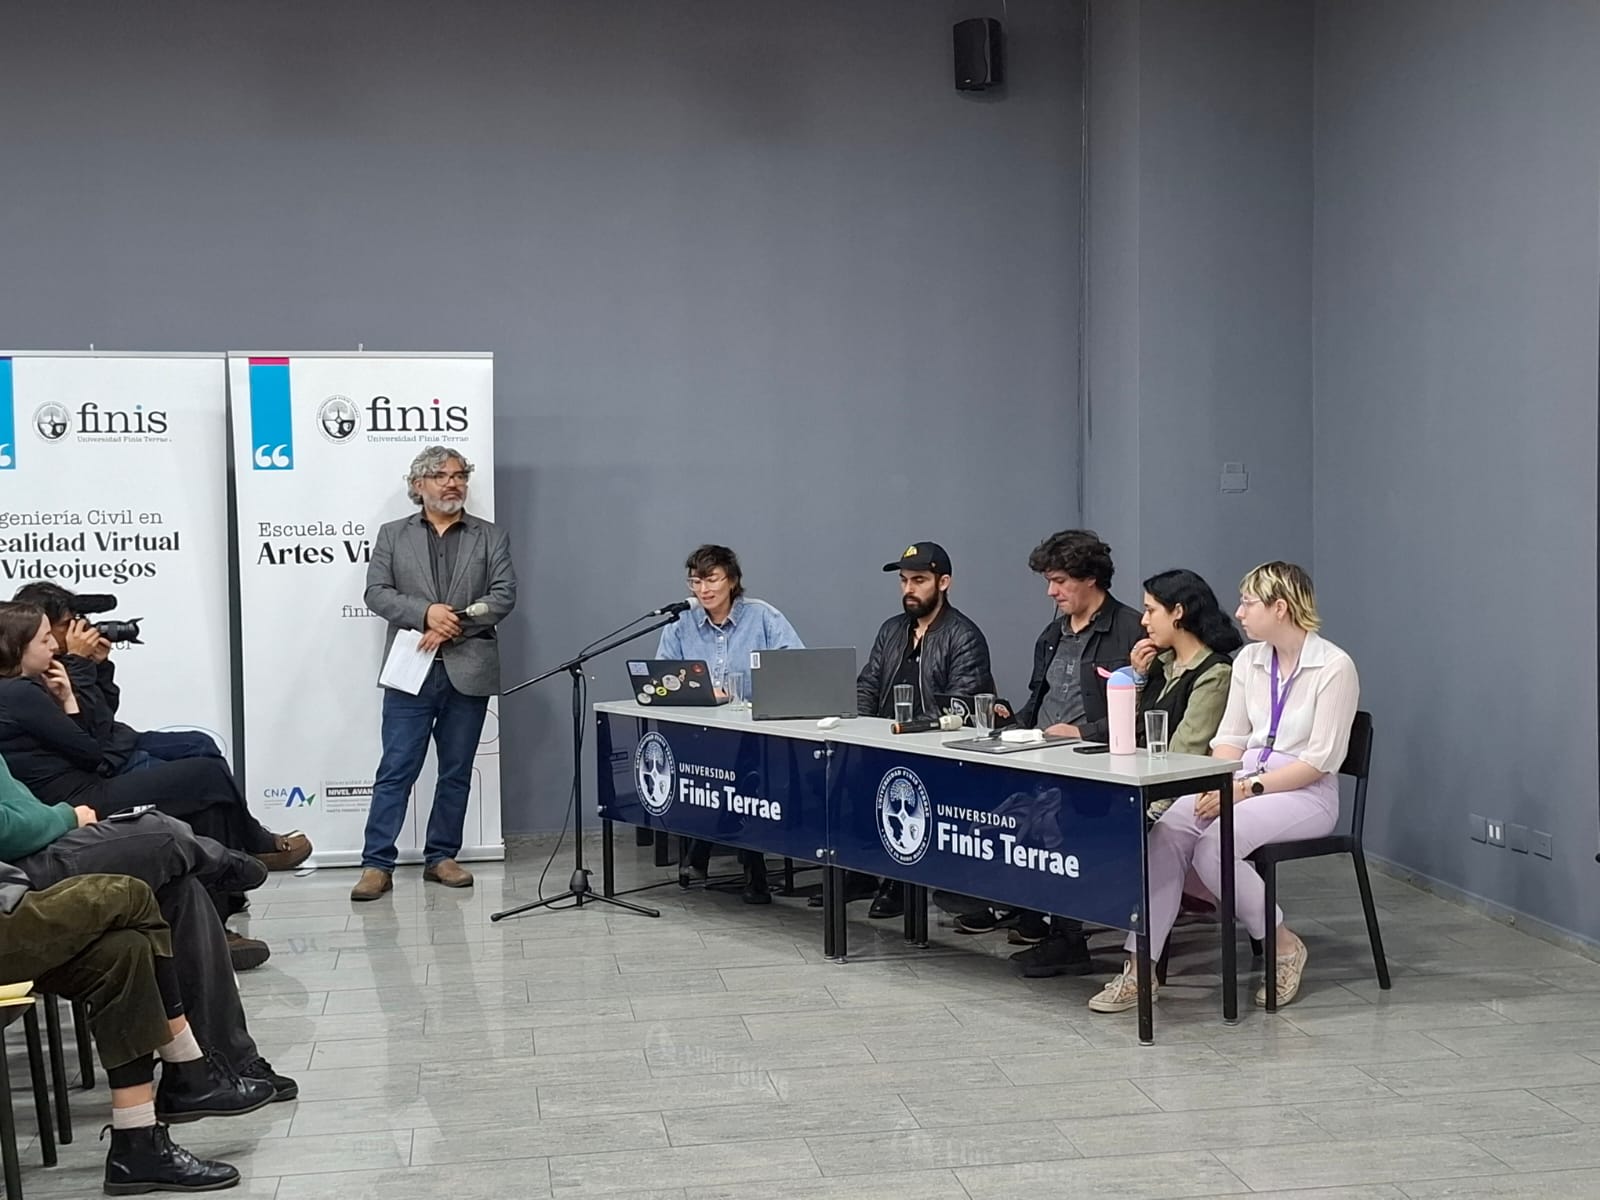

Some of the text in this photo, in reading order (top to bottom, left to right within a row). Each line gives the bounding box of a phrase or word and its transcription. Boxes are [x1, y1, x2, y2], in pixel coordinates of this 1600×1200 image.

[76, 402, 168, 434] finis
[365, 396, 469, 432] finis
[87, 509, 133, 525] Civil
[138, 512, 164, 525] en
[258, 521, 366, 537] Escuela de
[94, 531, 180, 551] Virtual
[257, 541, 335, 565] Artes
[1, 558, 157, 585] Videojuegos
[679, 762, 736, 781] UNIVERSIDAD
[263, 788, 288, 798] CNA
[679, 778, 720, 809] Finis
[723, 785, 782, 821] Terrae
[937, 804, 1016, 829] UNIVERSIDAD
[937, 822, 994, 861] Finis
[1000, 833, 1080, 878] Terrae
